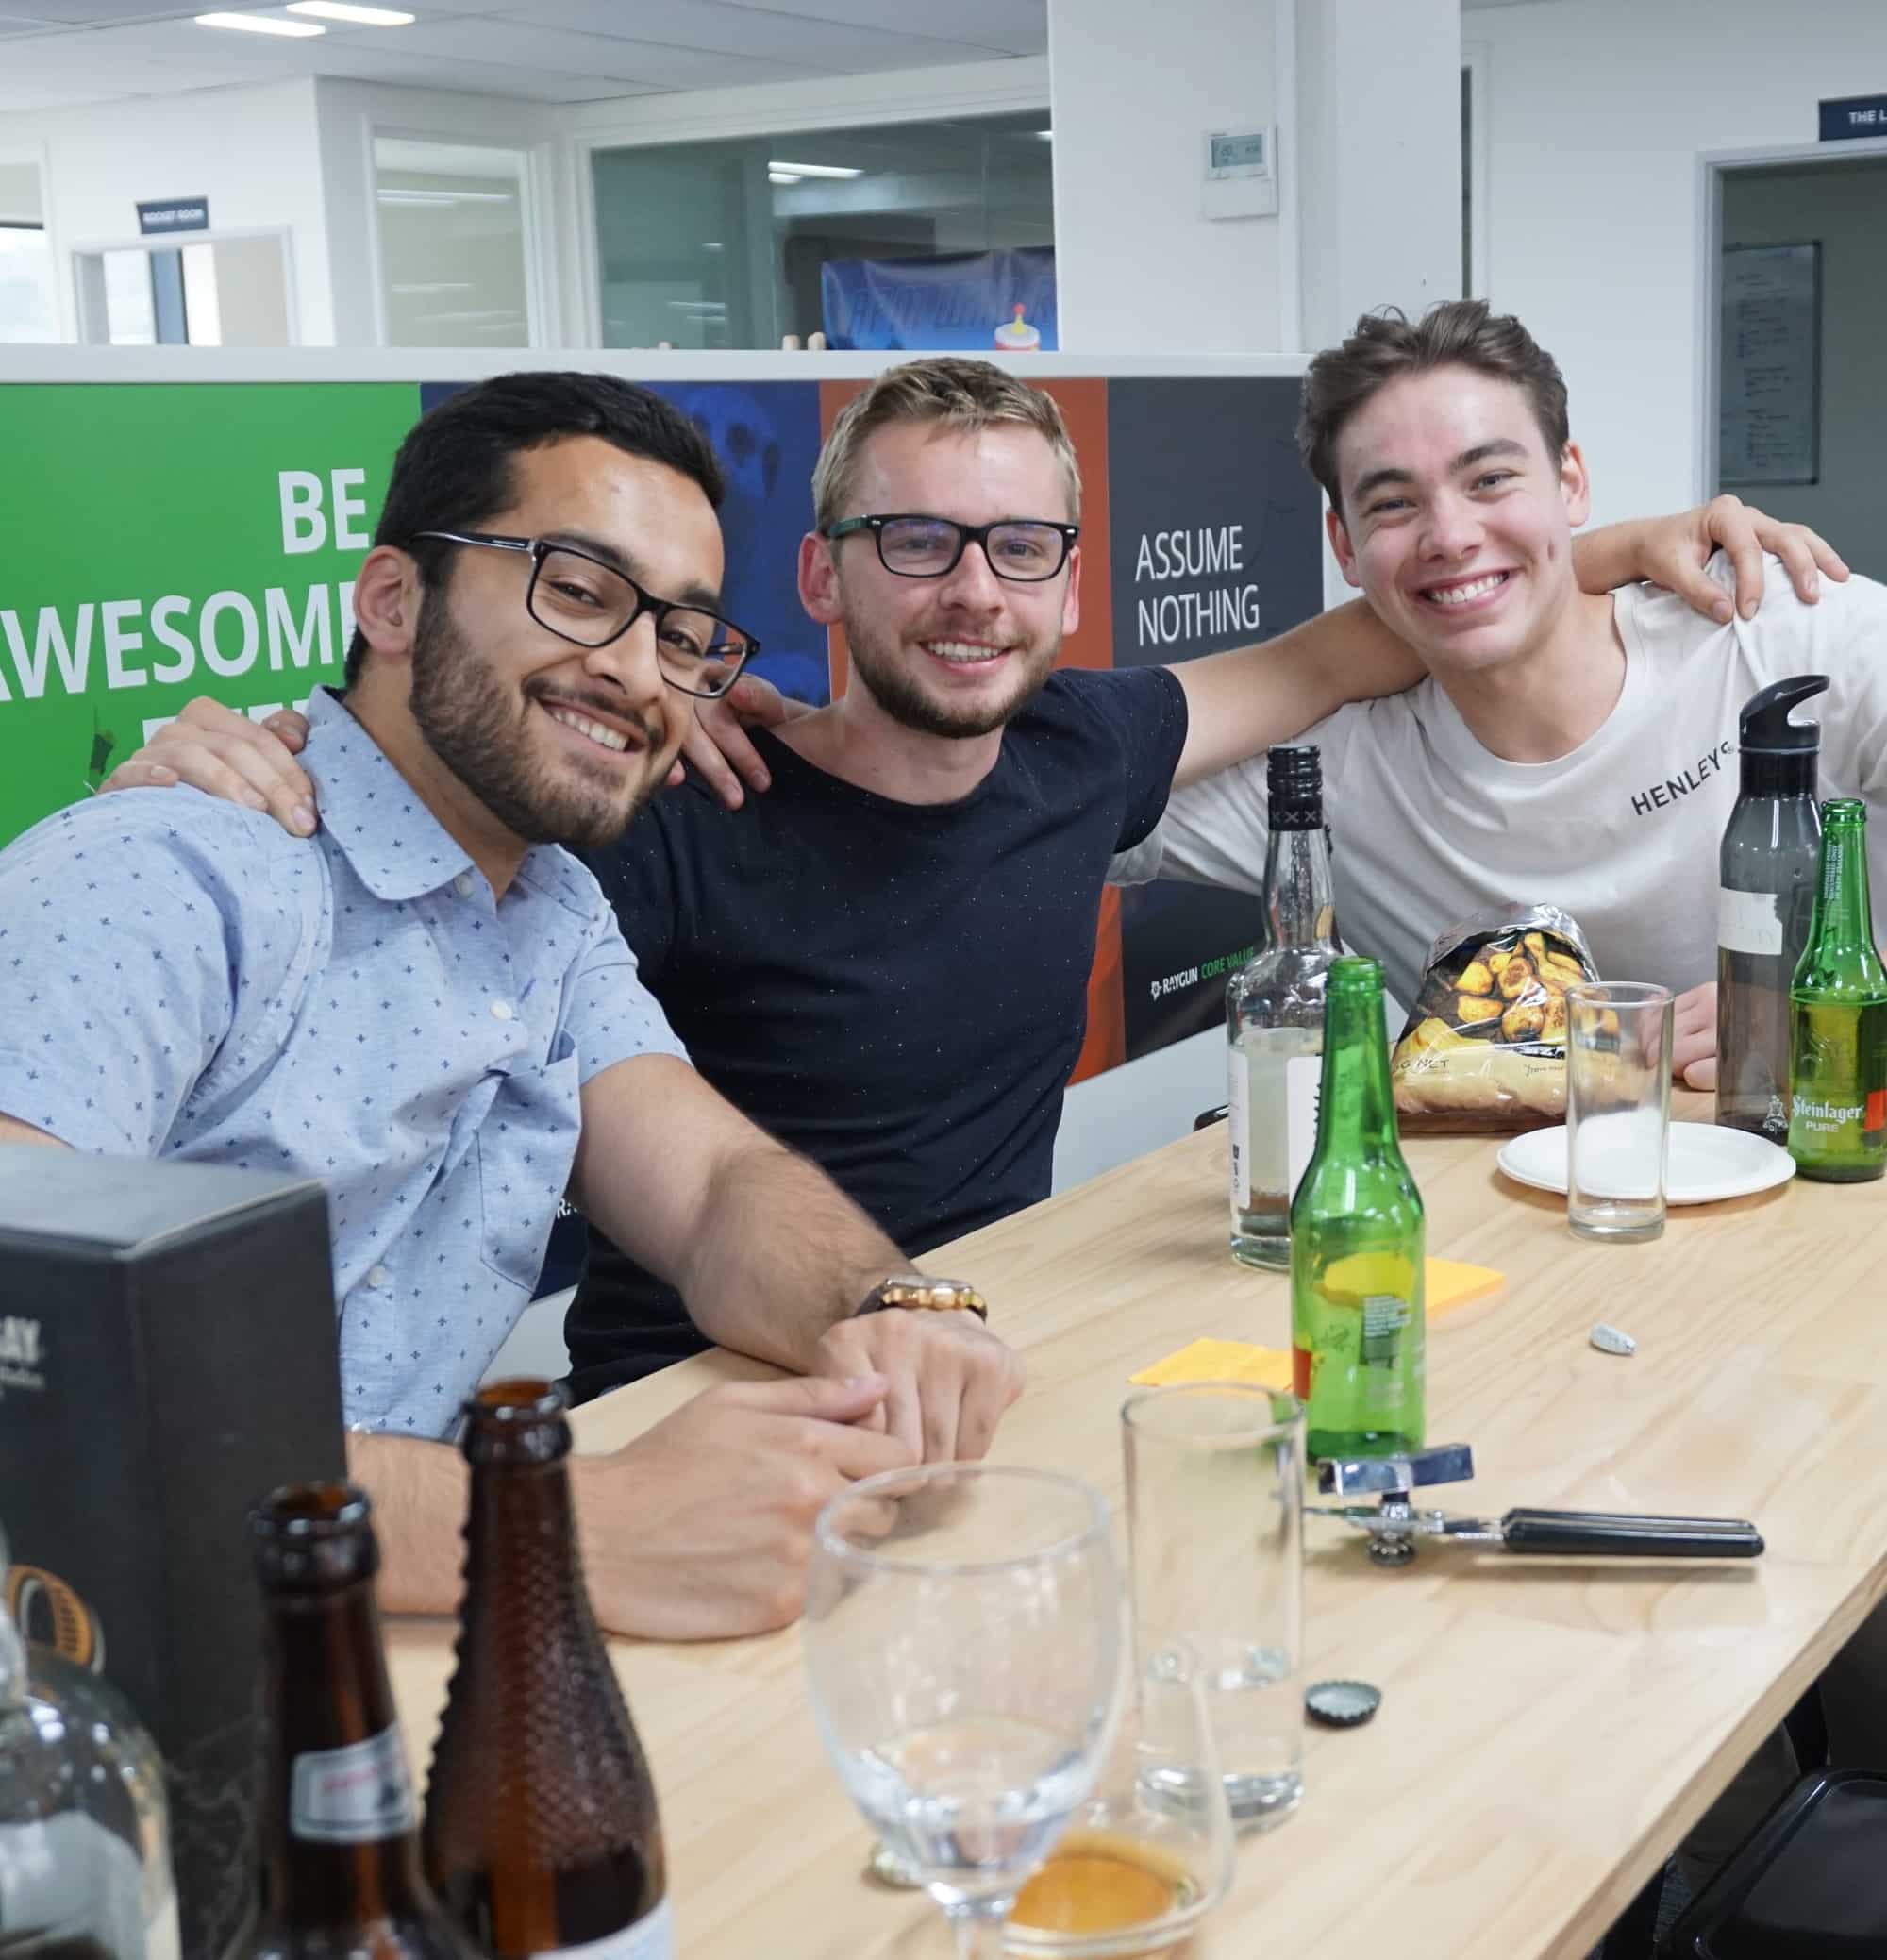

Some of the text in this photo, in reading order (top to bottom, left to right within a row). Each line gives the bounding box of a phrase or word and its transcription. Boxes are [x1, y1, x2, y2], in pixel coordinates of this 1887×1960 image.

[1848, 109, 1877, 124] THE
[278, 468, 369, 554] BE
[1135, 525, 1243, 581] ASSUME
[1138, 584, 1260, 646] NOTHING
[1162, 966, 1198, 996] RAYGUN
[1200, 958, 1226, 980] CORE
[1793, 1095, 1862, 1125] Steinlager
[1805, 1120, 1840, 1132] PURE
